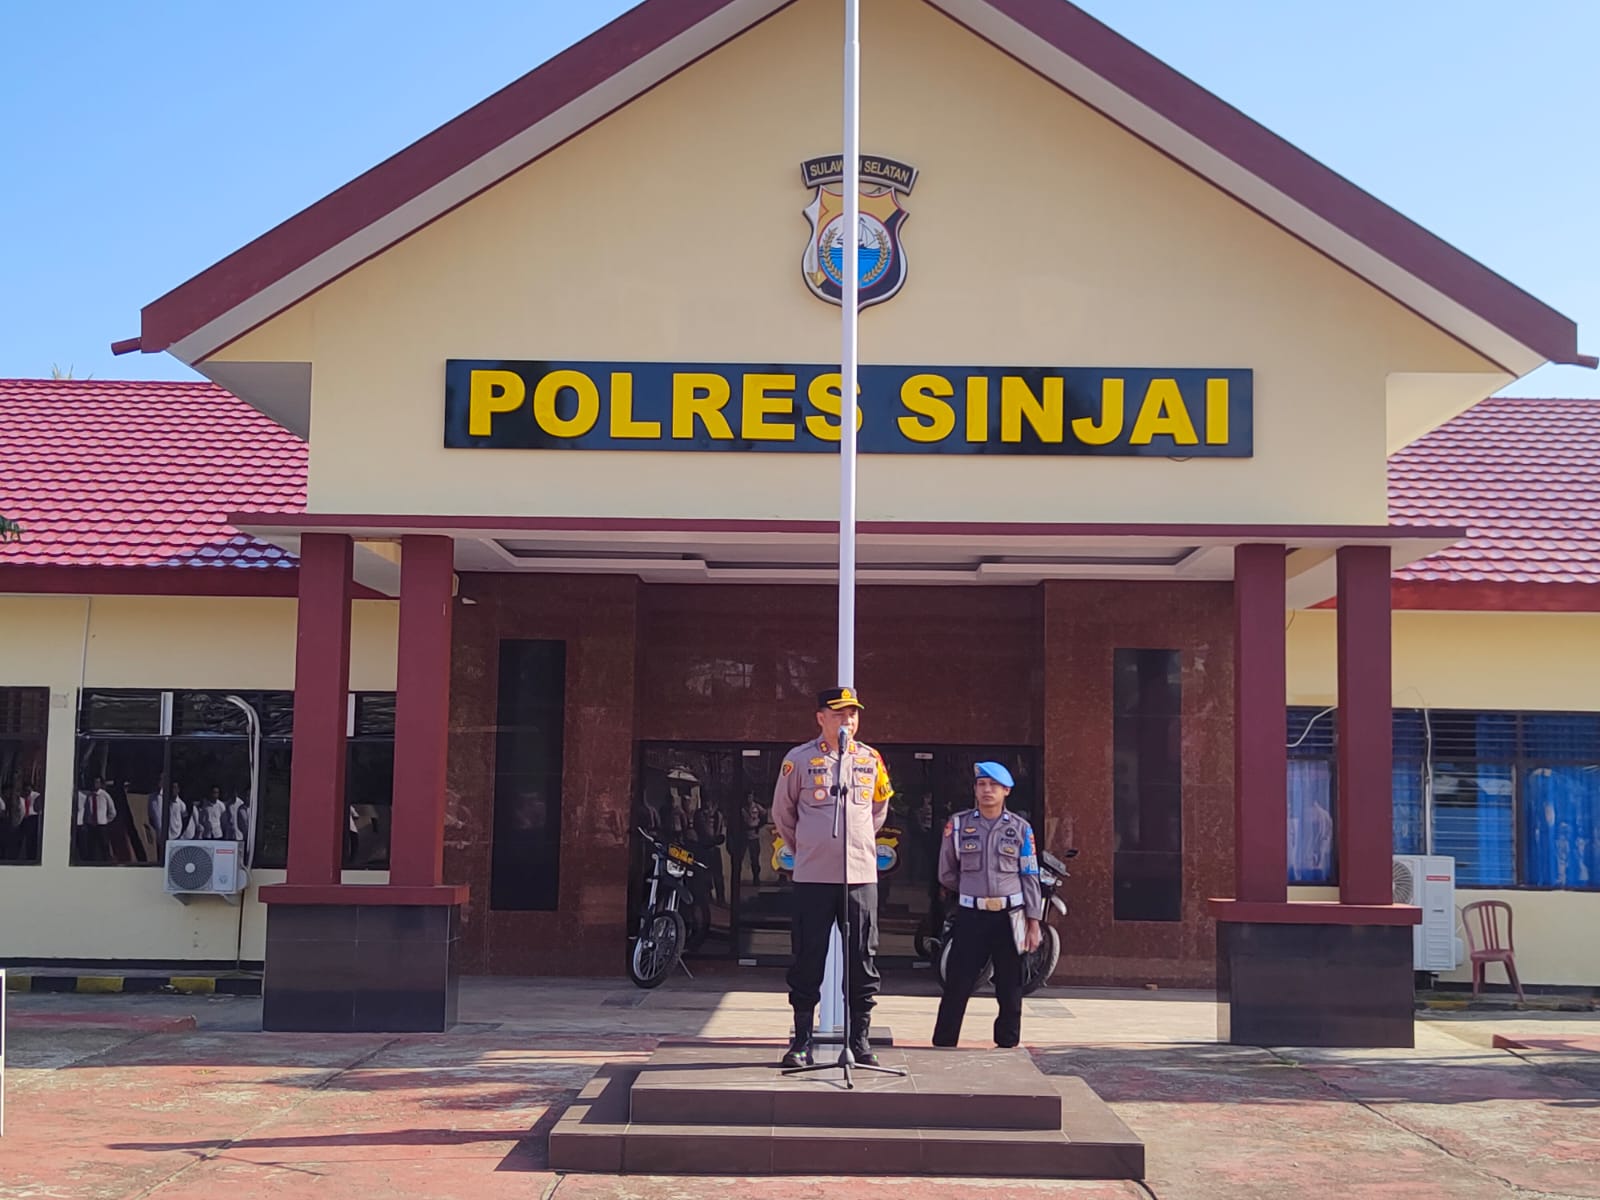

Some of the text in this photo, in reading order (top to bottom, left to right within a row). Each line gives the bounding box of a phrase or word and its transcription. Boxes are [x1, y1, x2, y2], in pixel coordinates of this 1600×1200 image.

[809, 160, 909, 183] SULAWI SELATAN
[469, 369, 1229, 445] POLRES SINJAI
